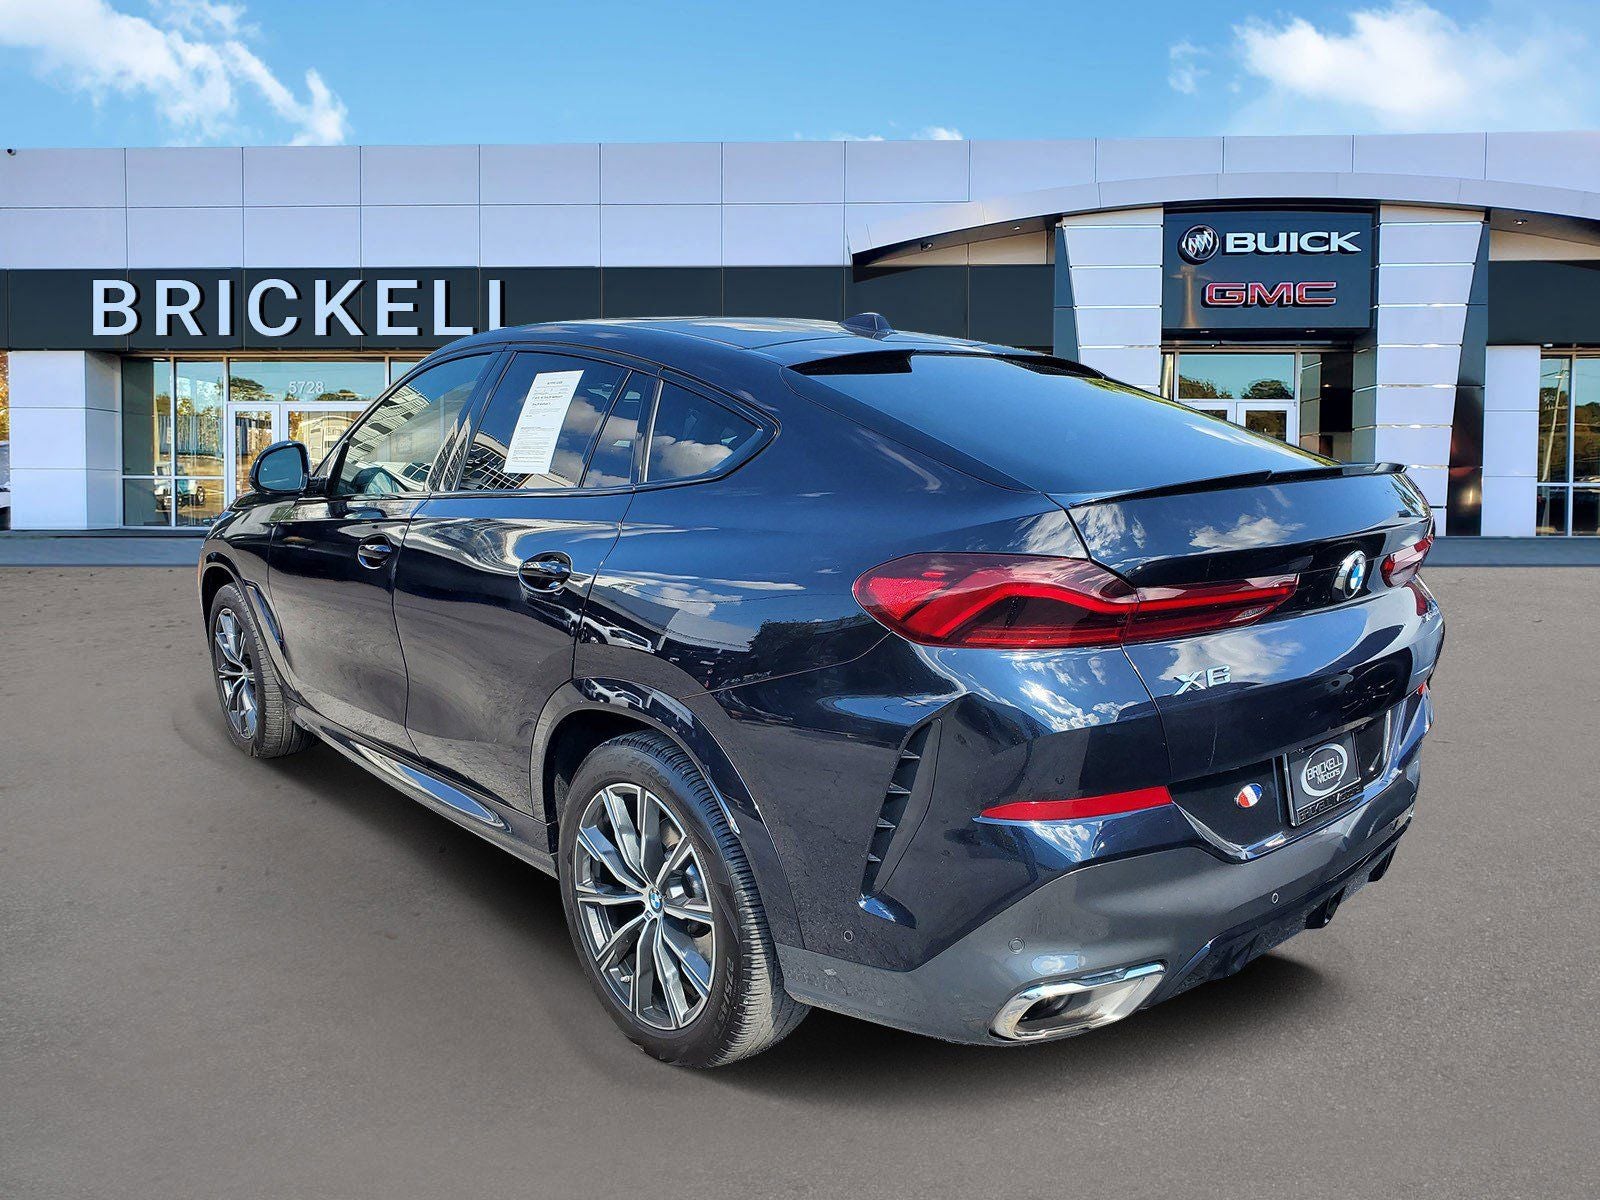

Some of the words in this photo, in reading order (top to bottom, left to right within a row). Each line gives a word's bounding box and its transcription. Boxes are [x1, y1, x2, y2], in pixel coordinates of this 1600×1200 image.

[1225, 231, 1362, 253] BUICK
[1205, 281, 1337, 305] GMC
[288, 381, 325, 394] 5728
[1173, 665, 1232, 696] X6
[1306, 755, 1343, 781] BRICKELL
